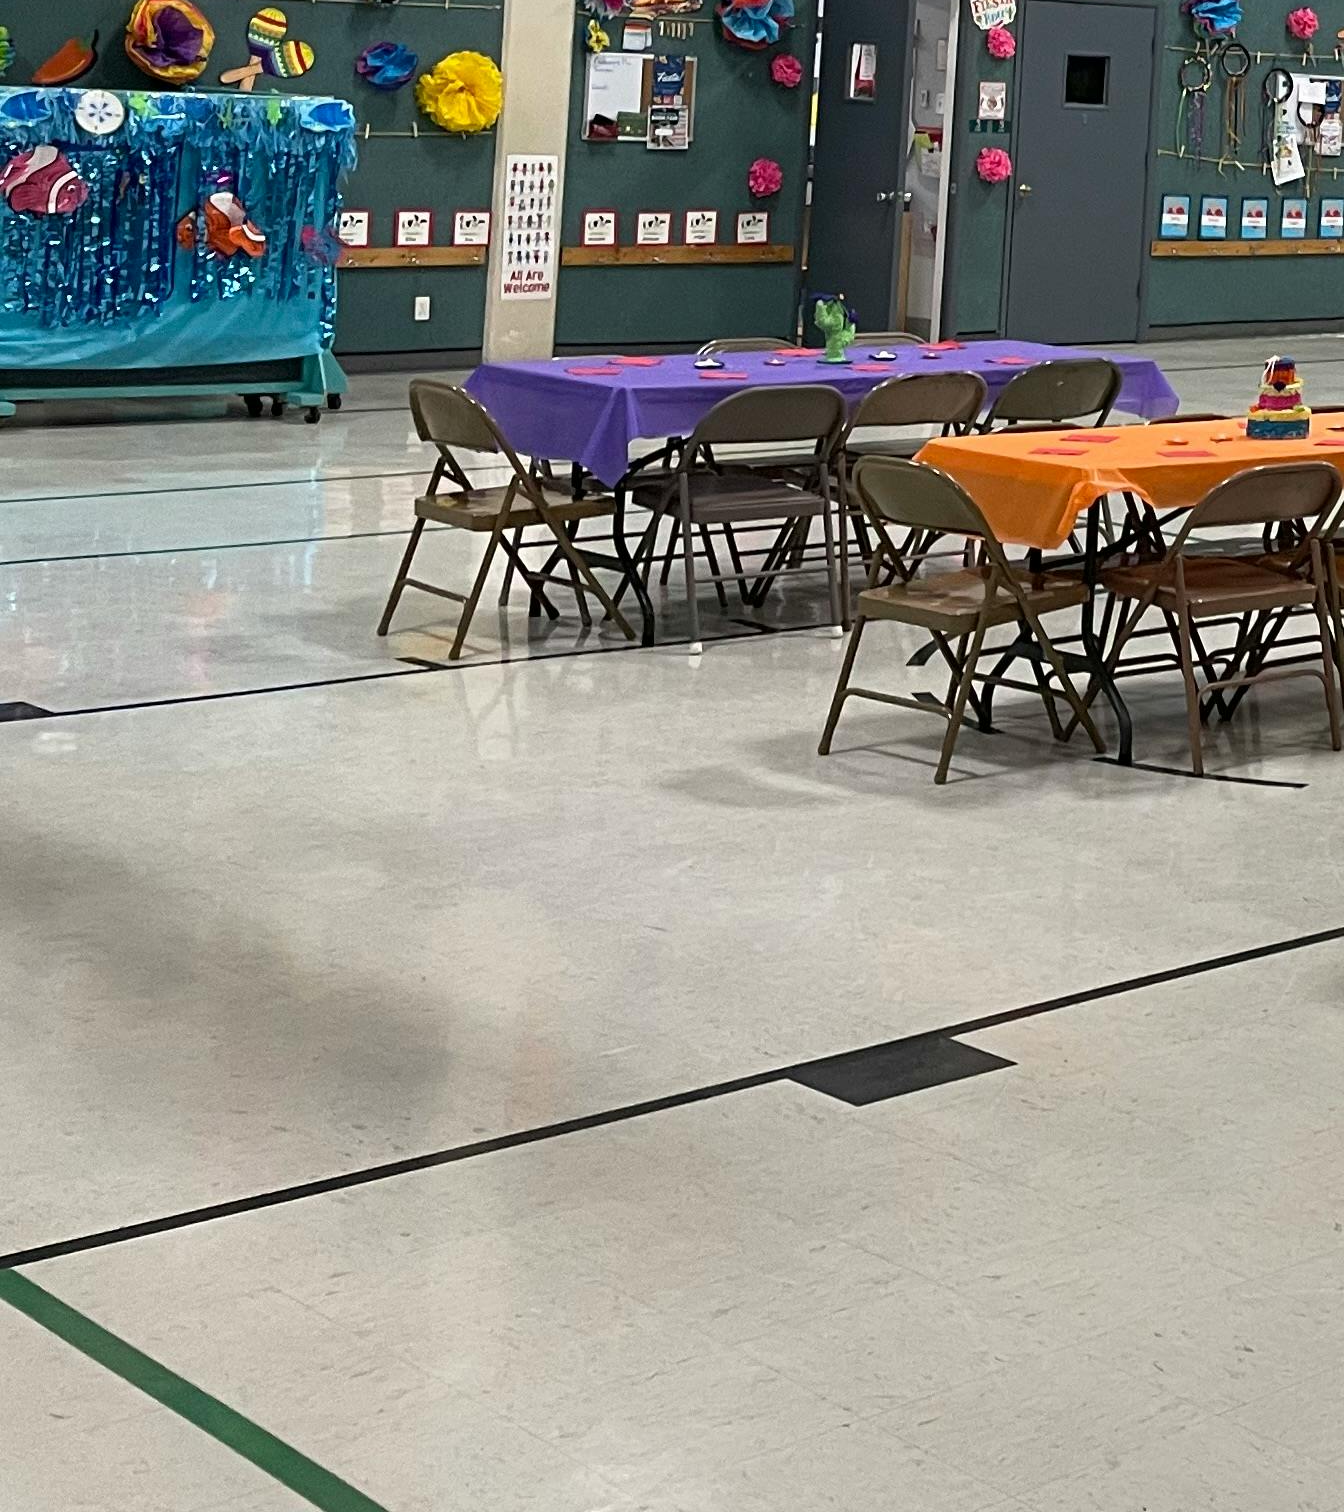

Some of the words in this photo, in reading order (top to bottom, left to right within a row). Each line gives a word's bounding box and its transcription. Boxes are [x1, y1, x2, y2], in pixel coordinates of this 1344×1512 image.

[510, 270, 523, 282] All
[526, 269, 544, 282] Are
[503, 282, 550, 294] Welcome
